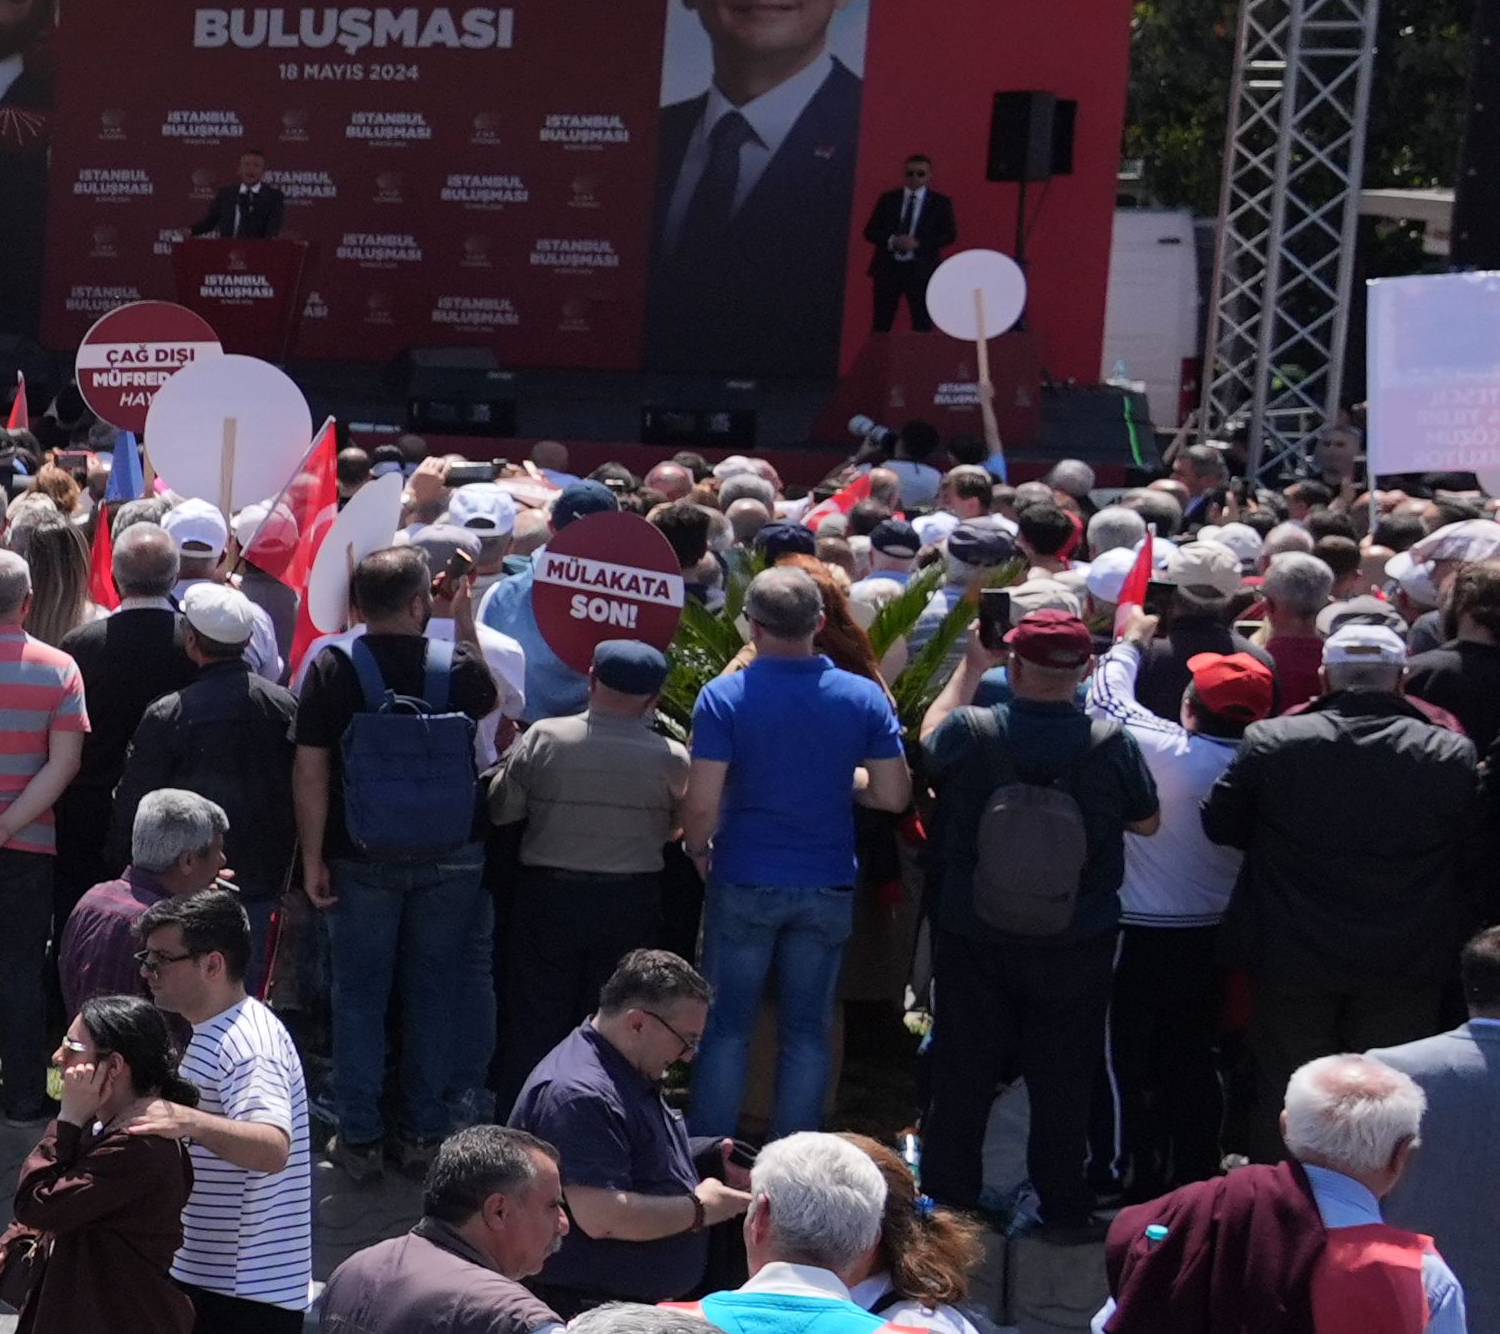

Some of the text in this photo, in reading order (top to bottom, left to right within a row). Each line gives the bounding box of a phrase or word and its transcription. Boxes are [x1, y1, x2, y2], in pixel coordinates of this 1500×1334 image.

[194, 8, 514, 55] BULUŞMASI
[278, 64, 420, 81] 18 MAYIS 2024
[106, 344, 195, 367] ÇAĞ DIŞI
[92, 369, 173, 387] MÜFRED
[546, 558, 670, 599] MÜLAKATA
[570, 594, 638, 629] SON!
